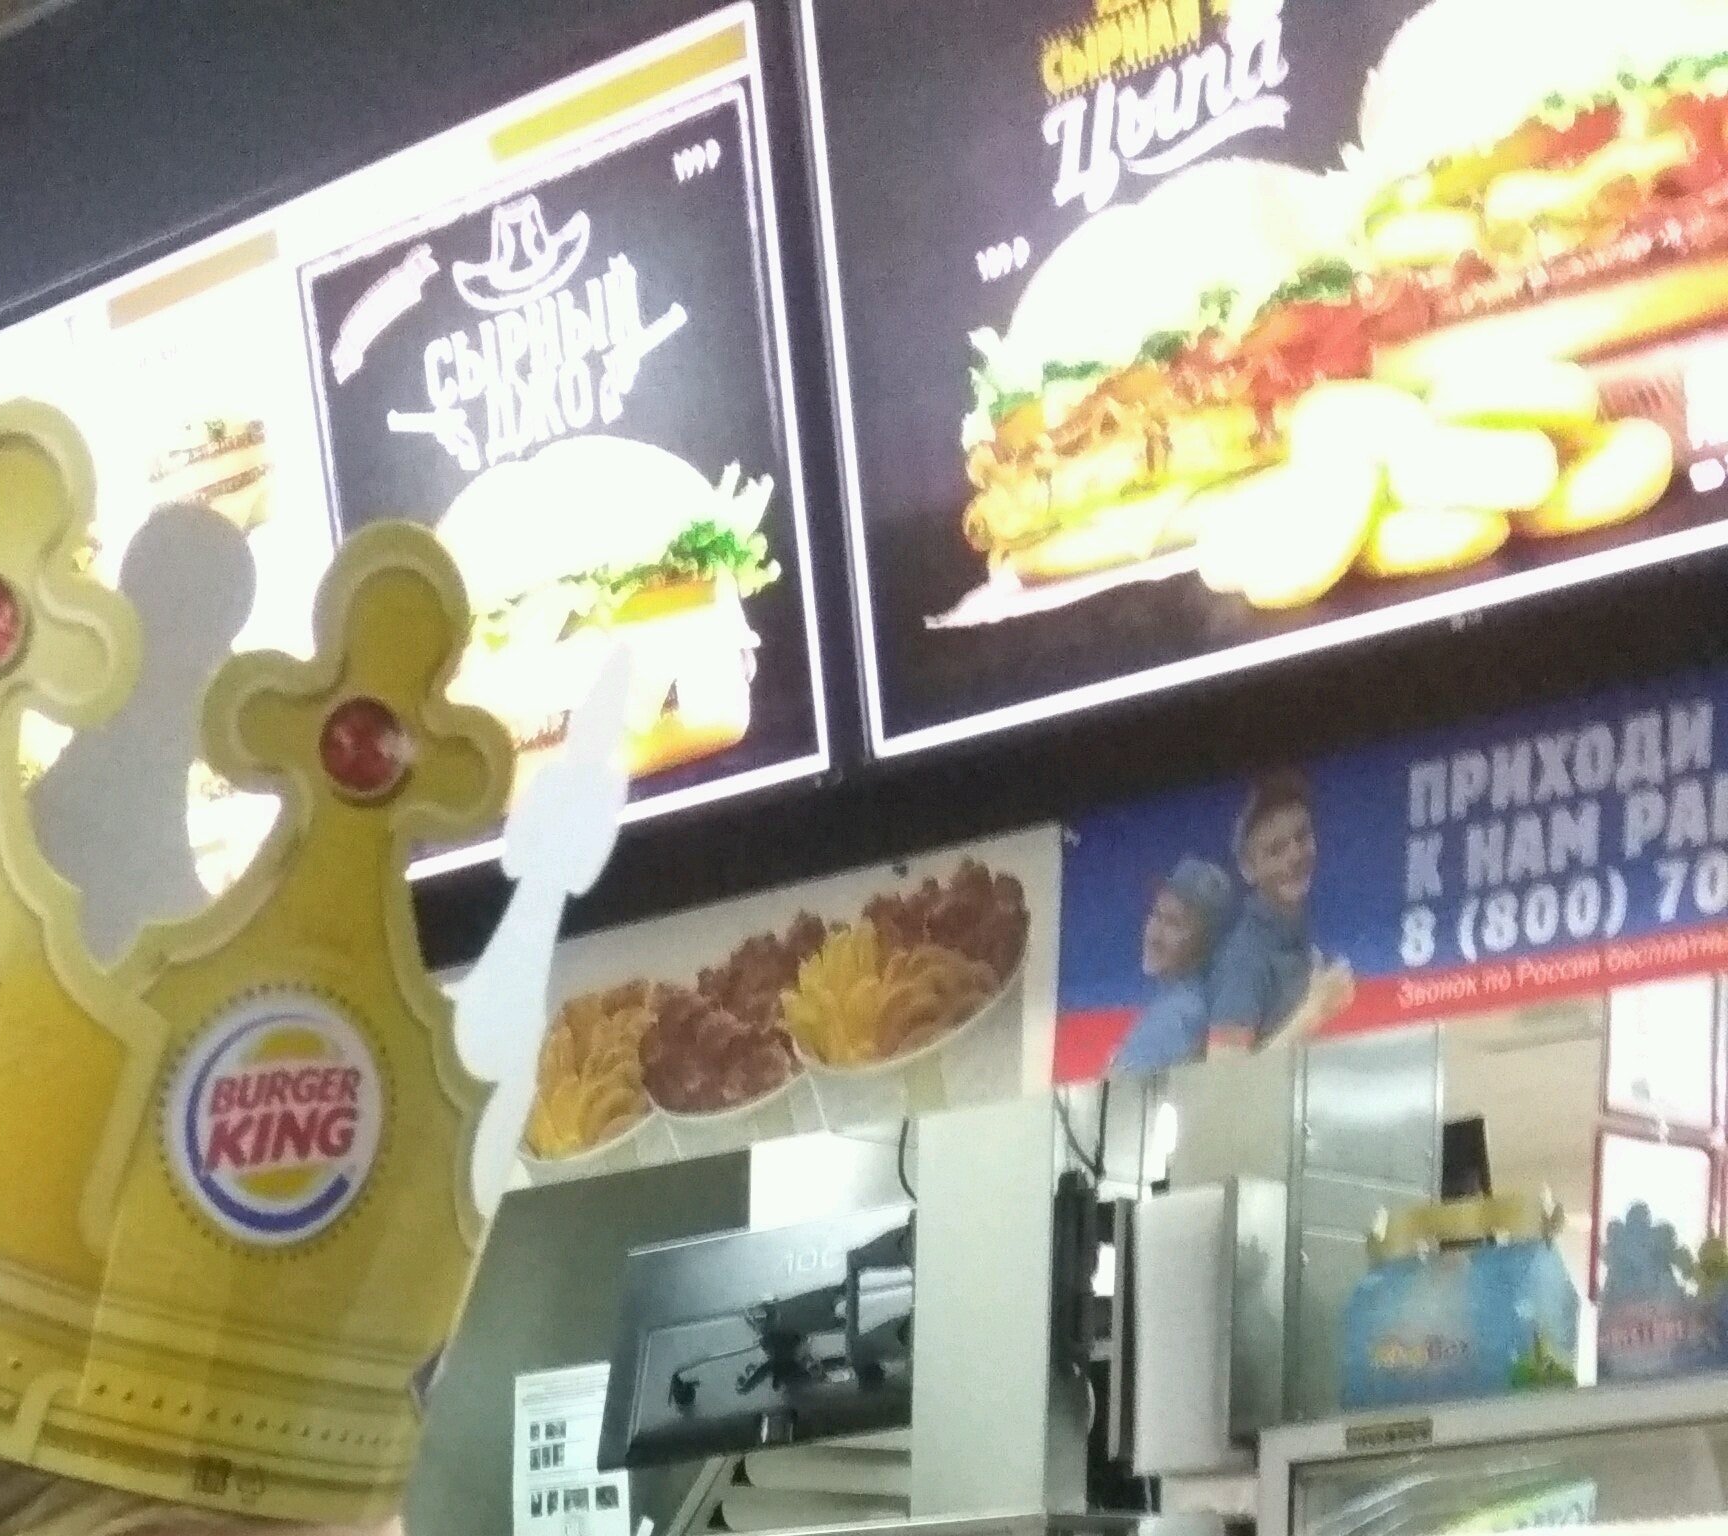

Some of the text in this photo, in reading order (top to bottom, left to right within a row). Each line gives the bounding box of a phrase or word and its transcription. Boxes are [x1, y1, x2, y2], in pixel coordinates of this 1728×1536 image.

[1407, 697, 1715, 828] ПРИХОДИ
[1406, 832, 1444, 900] К
[1466, 797, 1602, 890] НАМ
[1399, 904, 1436, 967] 8
[1458, 863, 1628, 964] (800)
[203, 1107, 355, 1174] KING
[209, 1065, 362, 1117] BURGER
